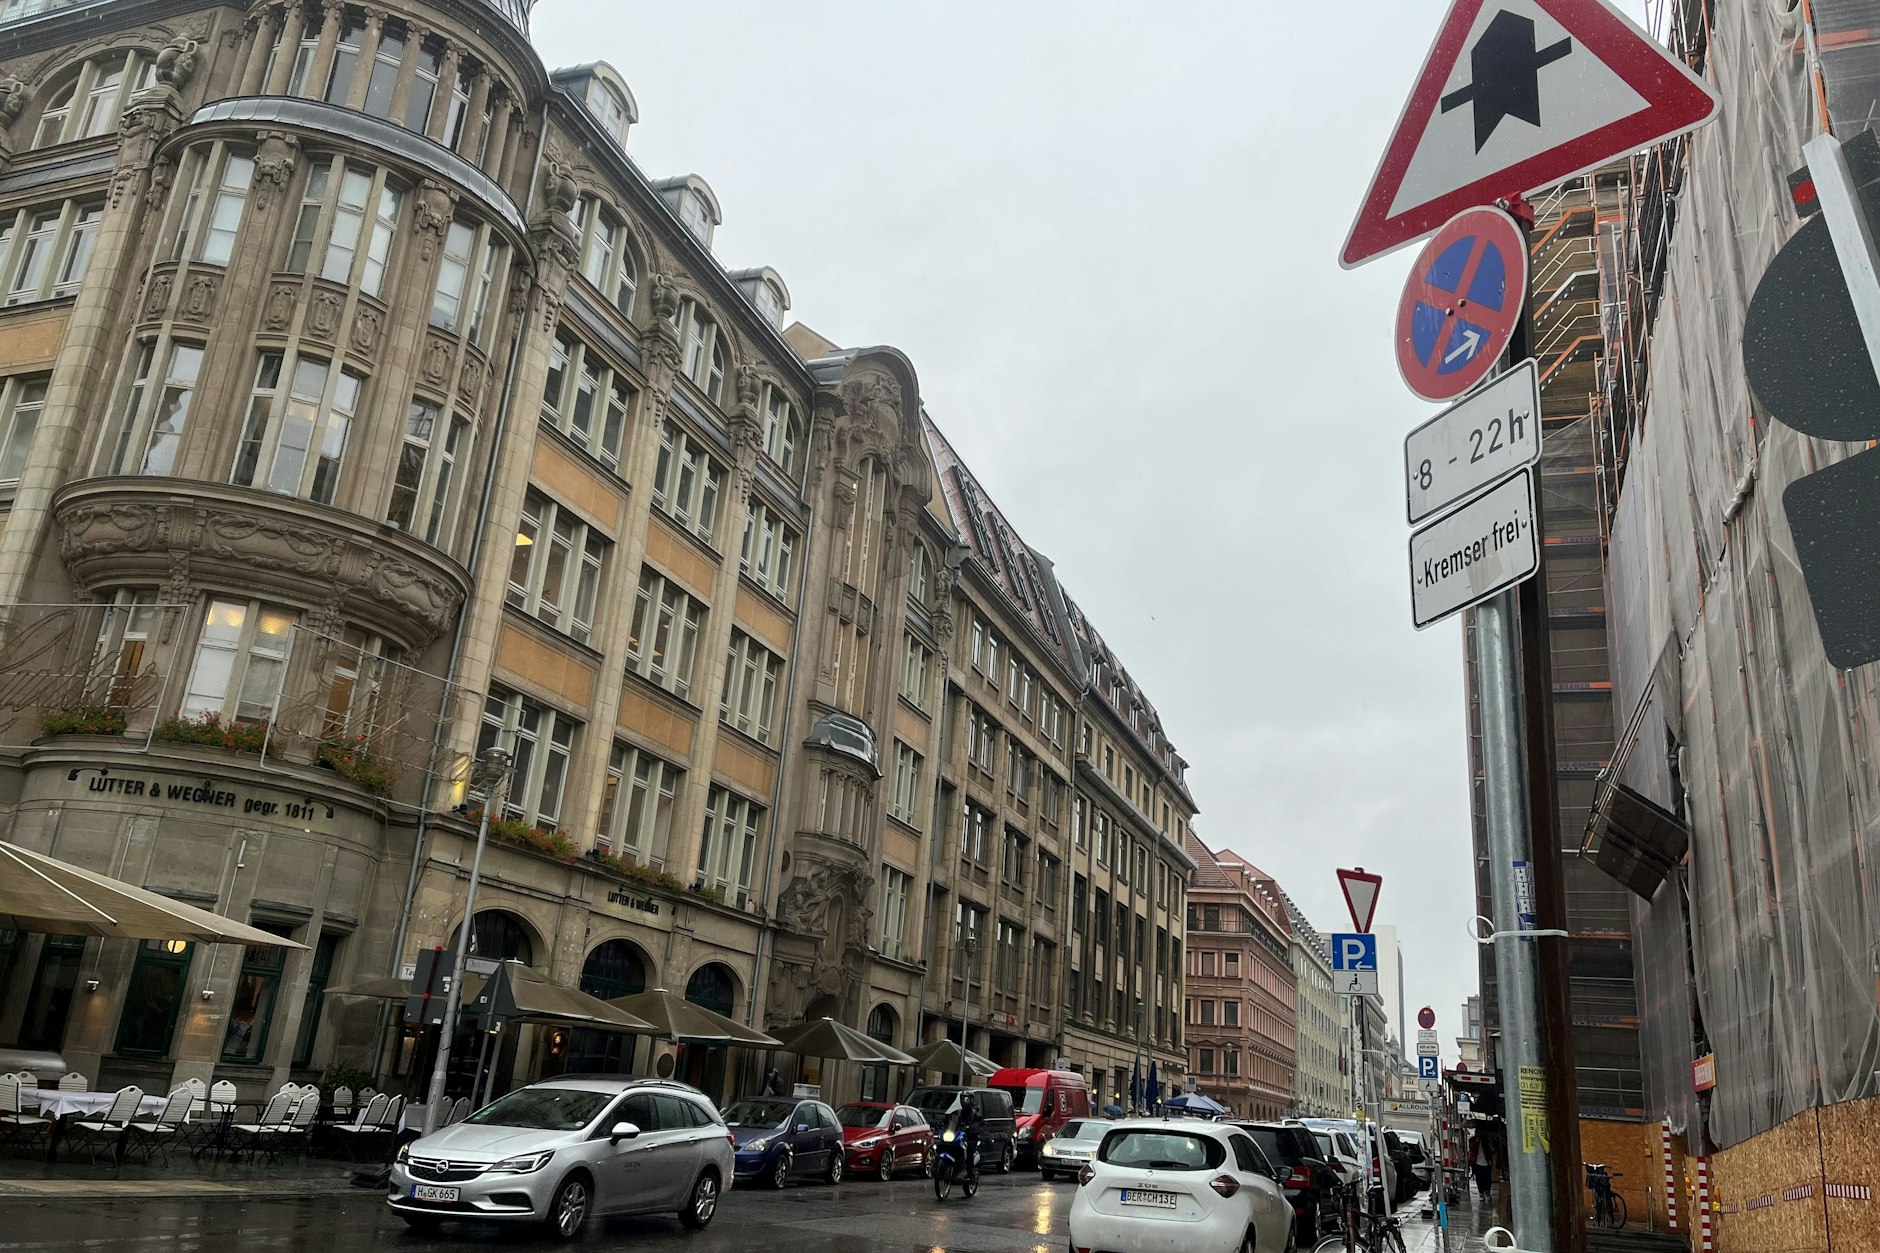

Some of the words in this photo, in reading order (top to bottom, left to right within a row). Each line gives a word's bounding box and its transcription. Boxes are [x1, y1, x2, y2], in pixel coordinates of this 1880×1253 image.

[1420, 459, 1432, 490] 8
[1424, 535, 1488, 588] Kremser
[1492, 509, 1520, 552] frei
[89, 776, 145, 796] LUTTER
[150, 782, 160, 797] &
[167, 784, 236, 808] WEGNER
[243, 797, 279, 816] gegr.
[285, 802, 315, 821] 1811
[1342, 939, 1366, 970] P
[1423, 1058, 1434, 1076] P
[1520, 1067, 1546, 1075] RENOV
[1399, 1103, 1429, 1111] ALLROUN
[417, 1186, 424, 1197] H
[427, 1187, 438, 1198] GK
[439, 1189, 455, 1200] 665
